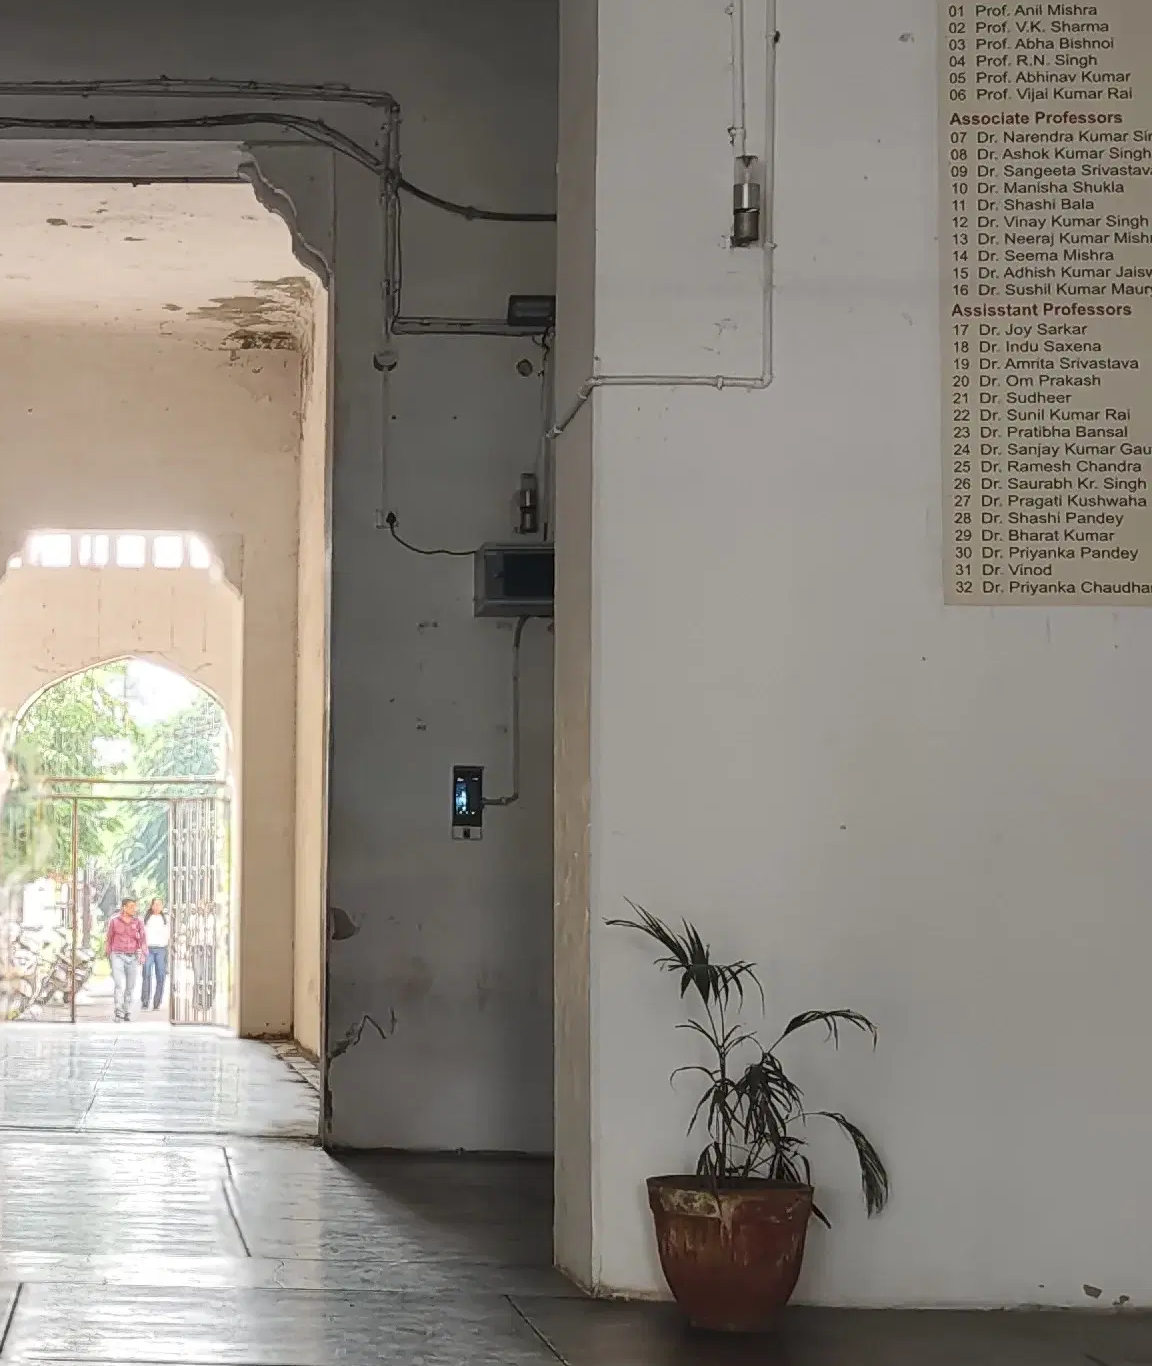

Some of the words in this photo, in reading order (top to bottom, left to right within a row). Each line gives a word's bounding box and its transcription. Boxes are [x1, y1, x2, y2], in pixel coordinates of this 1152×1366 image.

[948, 5, 963, 17] 01
[1014, 4, 1042, 16] Anil
[1047, 3, 1097, 15] Mishra
[948, 22, 965, 33] 02
[1050, 20, 1108, 32] Sharma
[948, 38, 966, 51] 03
[1014, 37, 1054, 49] Abha
[1059, 36, 1114, 49] Bishnoi
[948, 54, 965, 67] 04
[1054, 53, 1097, 69] Singh
[949, 71, 966, 84] 05
[1015, 70, 1076, 83] Abhinav
[1081, 70, 1131, 83] Kumar
[949, 88, 966, 101] 06
[1016, 87, 1048, 102] Vijai
[1053, 87, 1103, 99] Kumar
[1107, 87, 1132, 99] Rai
[949, 111, 1029, 125] Associate
[1035, 110, 1122, 124] Professors
[950, 131, 967, 143] 07
[1003, 130, 1074, 143] Narendra
[1078, 129, 1128, 142] Kumar
[950, 148, 967, 160] 08
[1002, 147, 1050, 159] Ashok
[1054, 146, 1105, 159] Kumar
[1108, 146, 1151, 161] Singh
[950, 165, 968, 177] 09
[1003, 164, 1076, 179] Sangeeta
[1081, 163, 1152, 176] Srivastav
[952, 182, 968, 194] 10
[1003, 181, 1068, 193] Manisha
[1072, 180, 1124, 193] Shukla
[952, 199, 964, 211] 11
[1003, 198, 1055, 210] Shashi
[1061, 198, 1094, 210] Bala
[952, 216, 968, 228] 12
[1003, 215, 1046, 230] Vinay
[1051, 214, 1102, 227] Kumar
[1105, 214, 1148, 229] Singh
[952, 232, 968, 245] 13
[1004, 232, 1054, 247] Neeraj
[1059, 232, 1110, 244] Kumar
[953, 250, 968, 261] 14
[1004, 249, 1058, 261] Seema
[1063, 248, 1114, 261] Mishra
[952, 266, 968, 279] 15
[1003, 266, 1055, 279] Adhish
[1060, 266, 1111, 277] Kumar
[952, 284, 968, 295] 16
[1004, 282, 1050, 295] Sushil
[1056, 282, 1106, 295] Kumar
[1043, 302, 1132, 316] Professors
[953, 323, 969, 335] 17
[1004, 323, 1032, 338] Joy
[1036, 322, 1088, 335] Sarkar
[953, 340, 969, 353] 18
[1006, 340, 1038, 352] Indu
[1043, 340, 1101, 352] Saxena
[953, 358, 969, 369] 19
[1004, 357, 1054, 369] Amrita
[1059, 356, 1138, 369] Srivastava
[952, 374, 969, 387] 20
[1005, 374, 1033, 387] Om
[1038, 374, 1100, 386] Prakash
[952, 392, 968, 404] 21
[1006, 391, 1072, 403] Sudheer
[953, 408, 970, 421] 22
[1006, 408, 1044, 421] Sunil
[1049, 408, 1100, 421] Kumar
[1105, 408, 1130, 421] Rai
[953, 426, 970, 438] 23
[1007, 425, 1070, 438] Pratibha
[1075, 425, 1127, 437] Bansal
[953, 443, 970, 455] 24
[1007, 442, 1060, 458] Sanjay
[1064, 442, 1116, 455] Kumar
[953, 460, 970, 473] 25
[1007, 459, 1070, 472] Ramesh
[1076, 459, 1142, 473] Chandra
[953, 477, 970, 489] 26
[1007, 476, 1072, 489] Saurabh
[1077, 476, 1098, 489] Kr.
[1103, 477, 1146, 493] Singh
[954, 494, 970, 507] 27
[1008, 494, 1062, 509] Pragati
[1067, 494, 1147, 507] Kushwaha
[954, 512, 971, 524] 28
[1008, 511, 1060, 524] Shashi
[1065, 511, 1124, 527] Pandey
[954, 529, 972, 541] 29
[1008, 529, 1059, 541] Bharat
[1063, 528, 1115, 541] Kumar
[955, 546, 972, 558] 30
[1008, 546, 1075, 561] Priyanka
[1080, 546, 1138, 561] Pandey
[955, 563, 970, 575] 31
[1008, 563, 1052, 576] Vinod
[955, 580, 972, 593] 32
[1009, 580, 1076, 595] Priyanka
[1080, 580, 1152, 593] Chaudha
